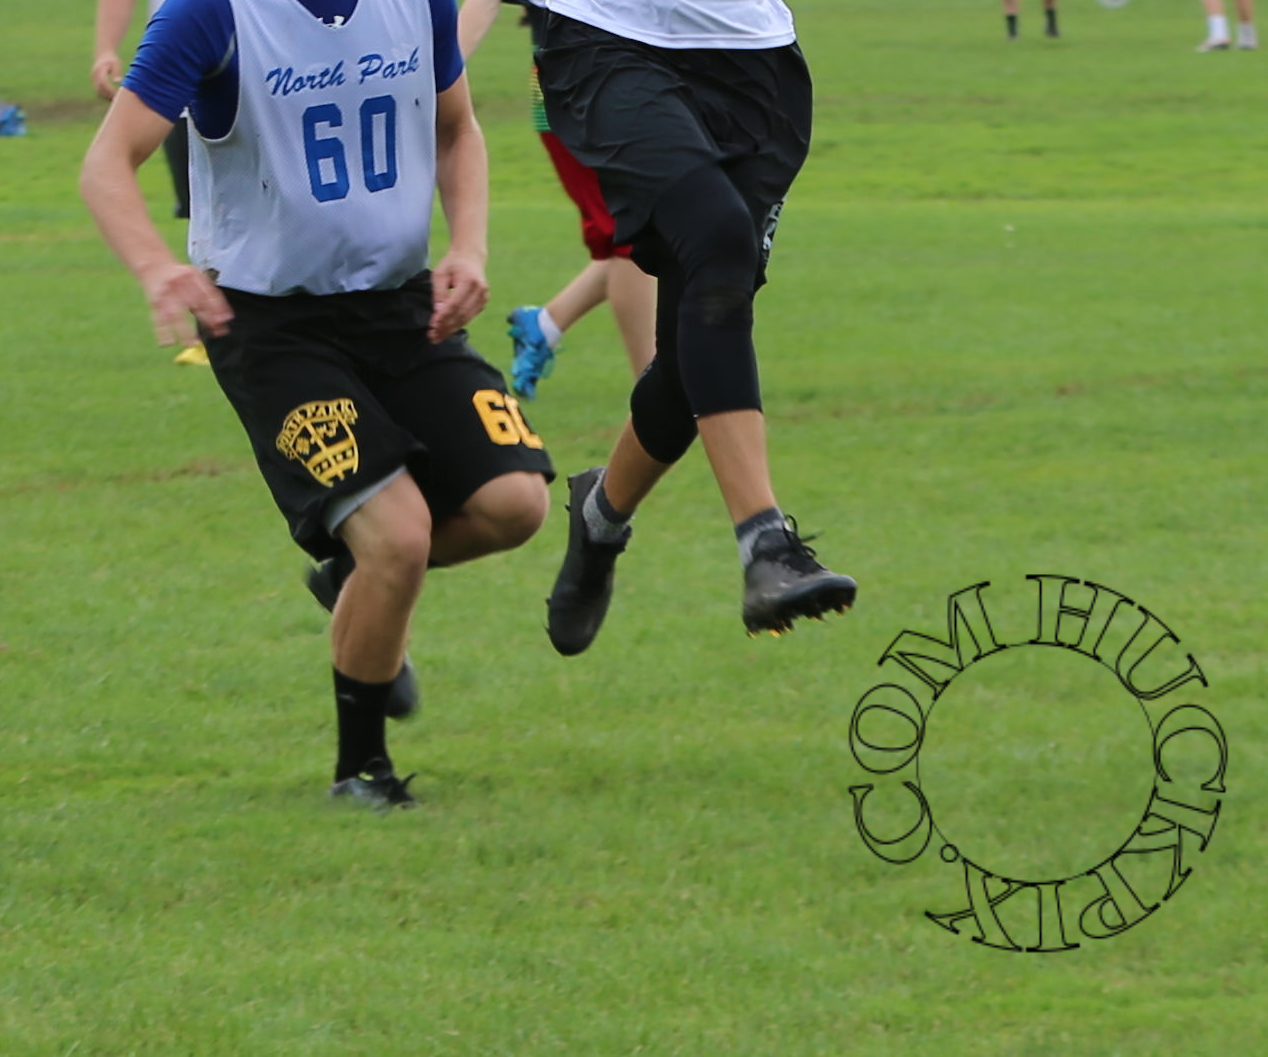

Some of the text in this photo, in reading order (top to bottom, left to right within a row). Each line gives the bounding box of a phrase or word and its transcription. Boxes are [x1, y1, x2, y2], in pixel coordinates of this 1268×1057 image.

[265, 46, 420, 96] North Park
[302, 95, 398, 203] 60
